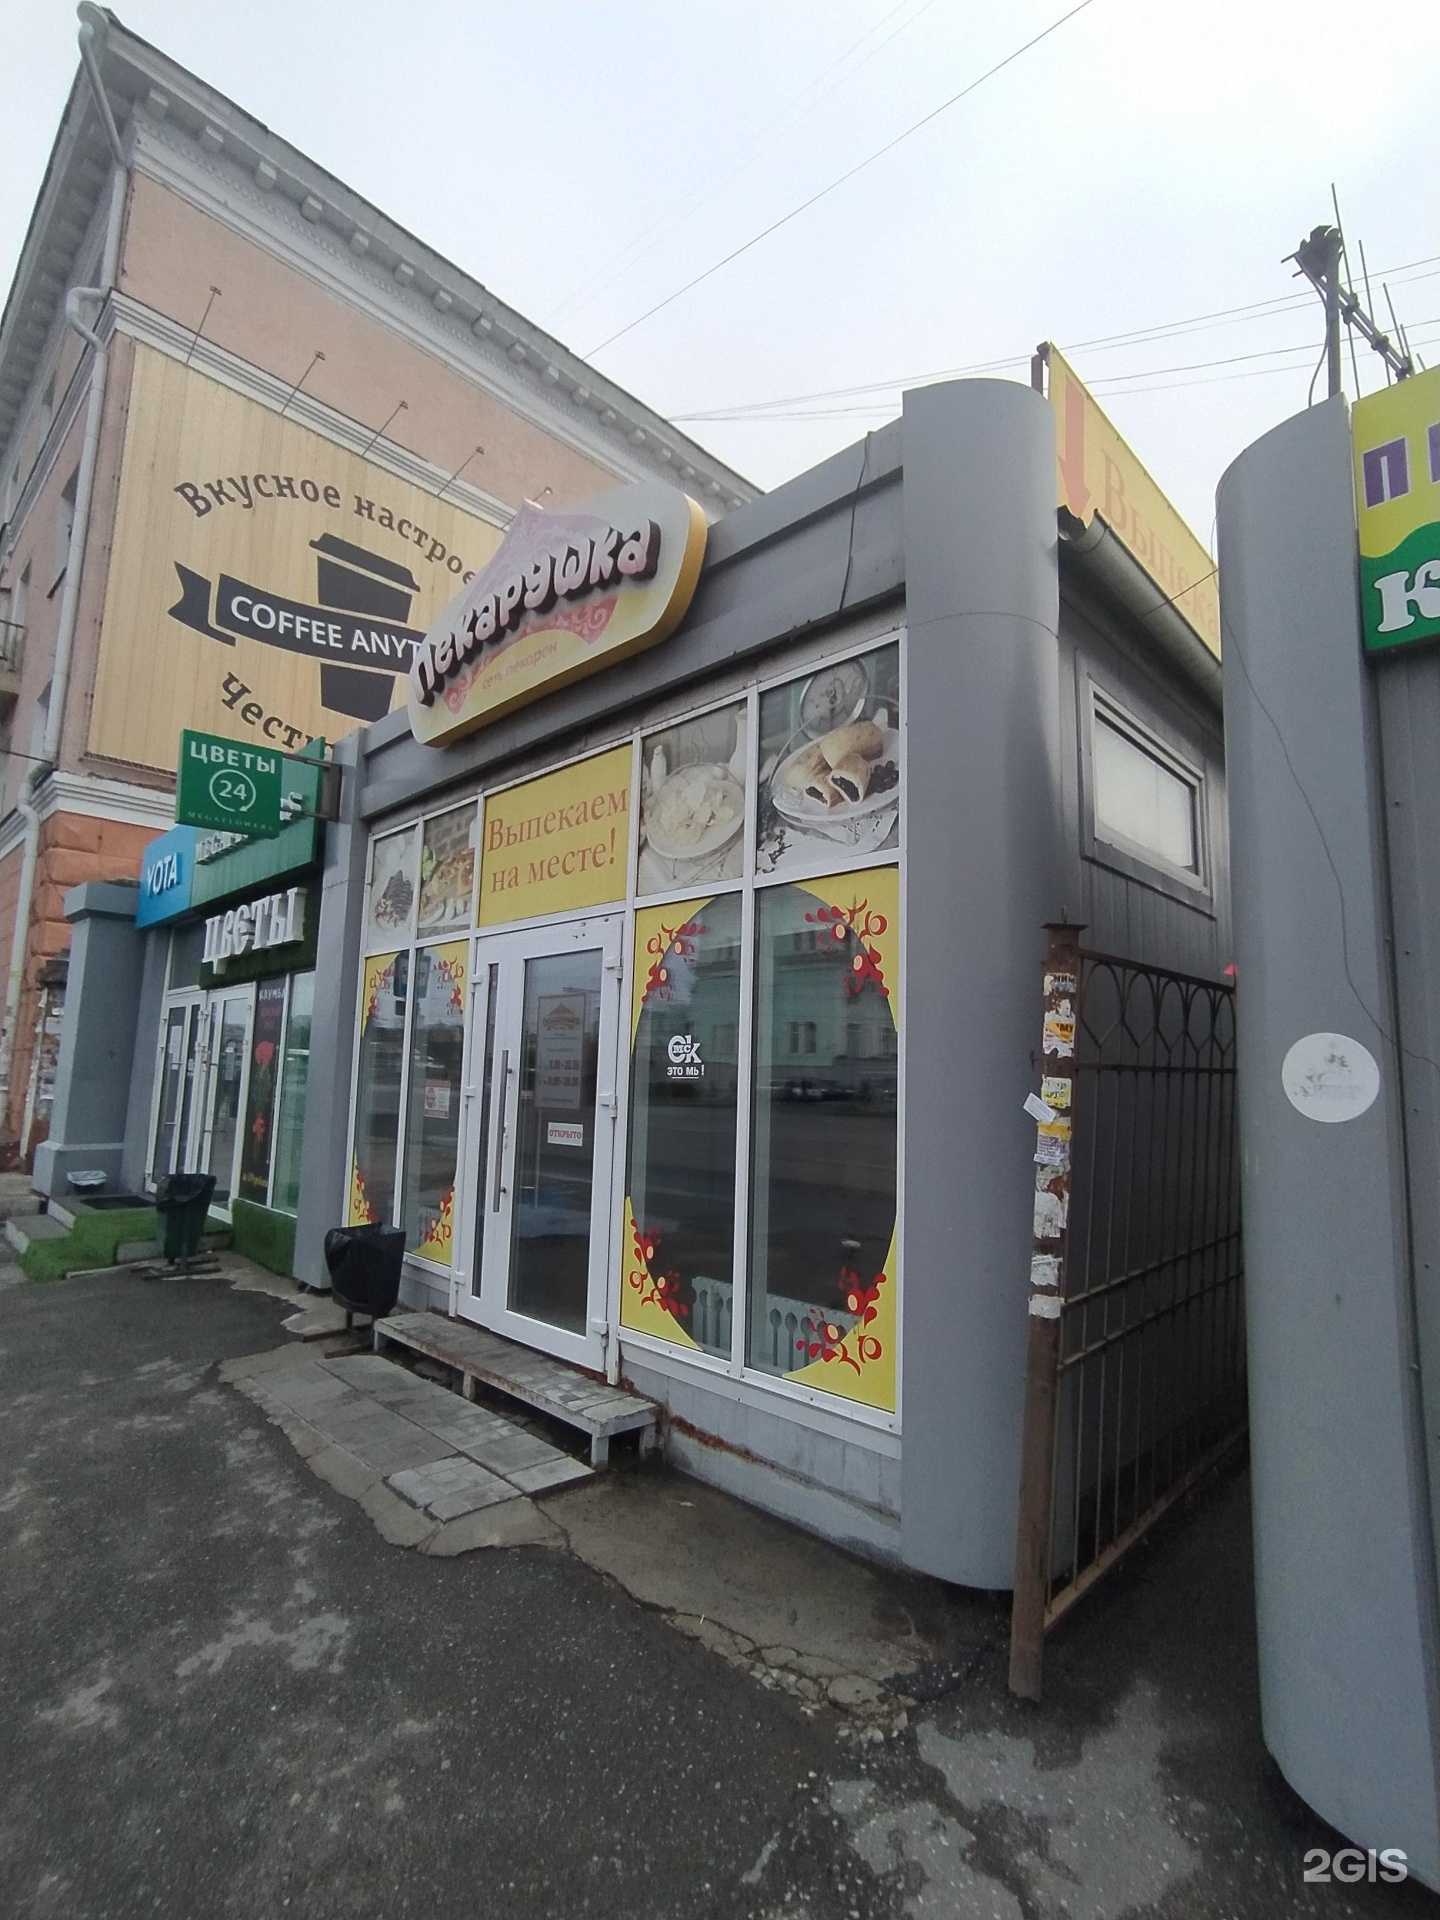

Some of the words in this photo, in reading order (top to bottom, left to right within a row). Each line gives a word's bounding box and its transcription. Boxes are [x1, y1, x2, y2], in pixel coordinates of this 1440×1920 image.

[174, 474, 341, 518] Вкусное
[231, 596, 343, 648] COFFEE
[411, 517, 661, 707] Пекарушка
[221, 671, 334, 749] Чест
[190, 741, 276, 775] ЦВЕТЫ
[218, 779, 248, 801] 24
[487, 787, 628, 852] Выпекаем
[146, 852, 180, 897] YOTA
[491, 865, 519, 893] на
[527, 827, 616, 884] месте!
[549, 1130, 582, 1139] ОТКРЫТО
